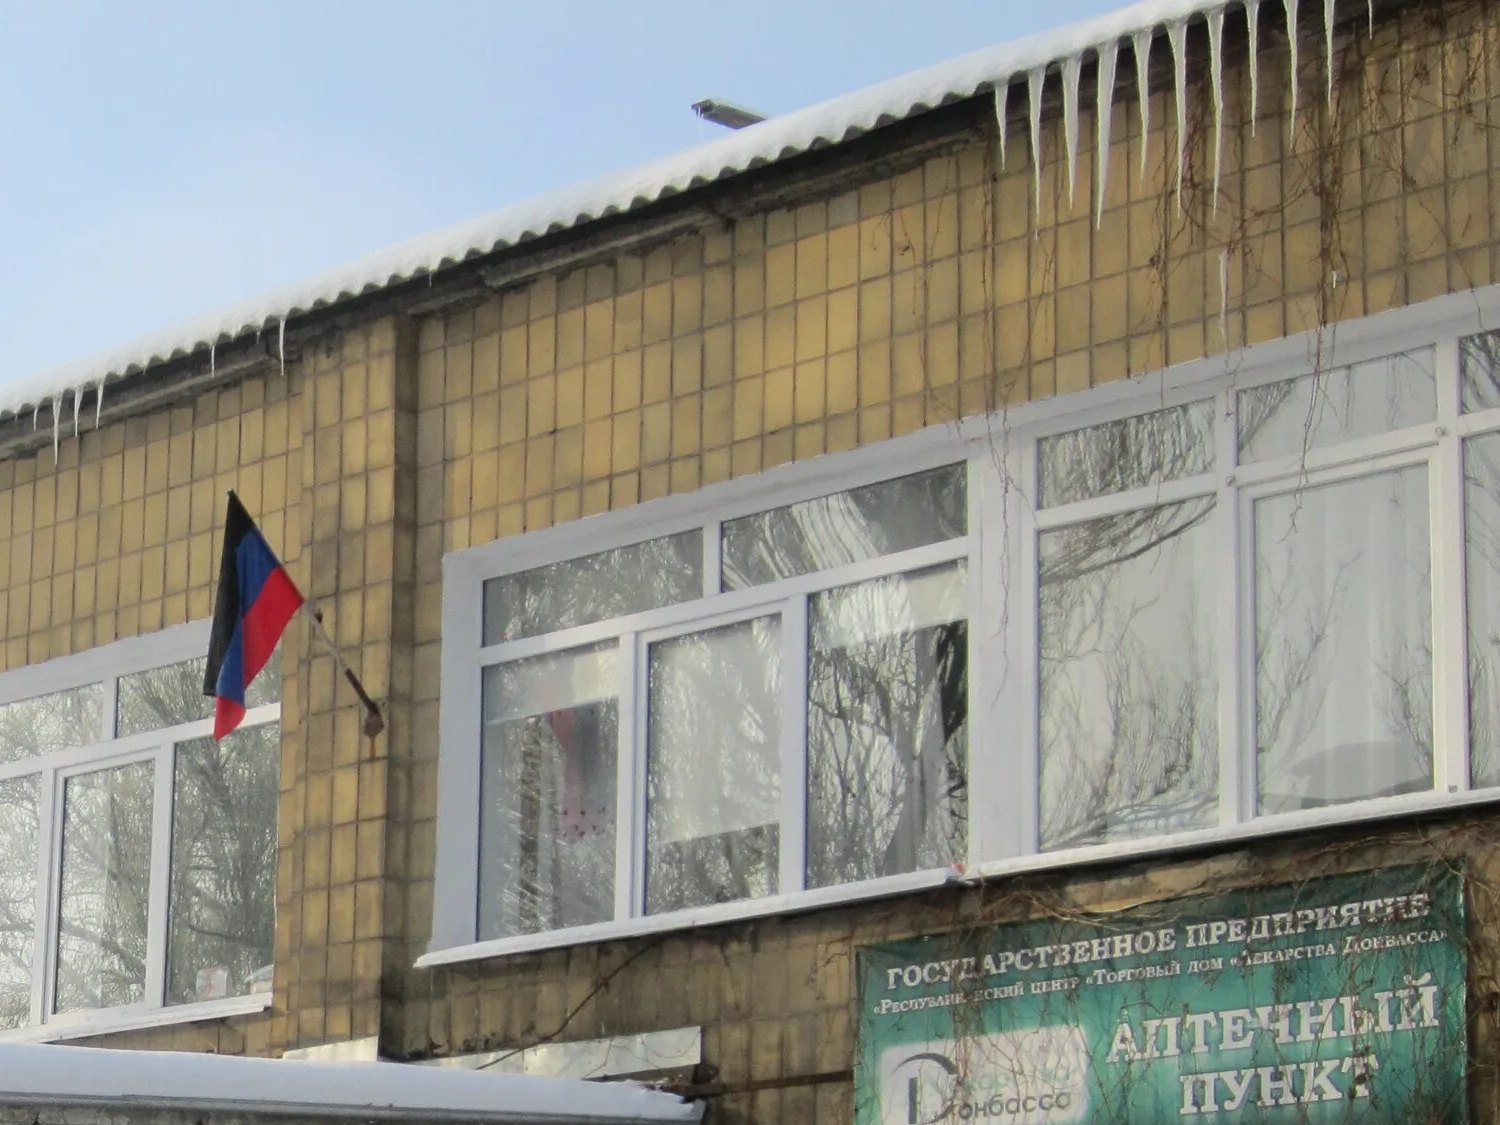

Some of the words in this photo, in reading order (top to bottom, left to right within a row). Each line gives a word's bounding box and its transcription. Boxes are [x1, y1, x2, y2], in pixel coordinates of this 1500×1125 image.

[887, 928, 1176, 990] ГОСУДАРСТВЕННОЕ
[1186, 893, 1430, 948] ПРЕДПРИЯТИЕ
[1106, 972, 1439, 1063] АПТЕЧНЫЙ
[1180, 1053, 1380, 1115] ПУНКТ
